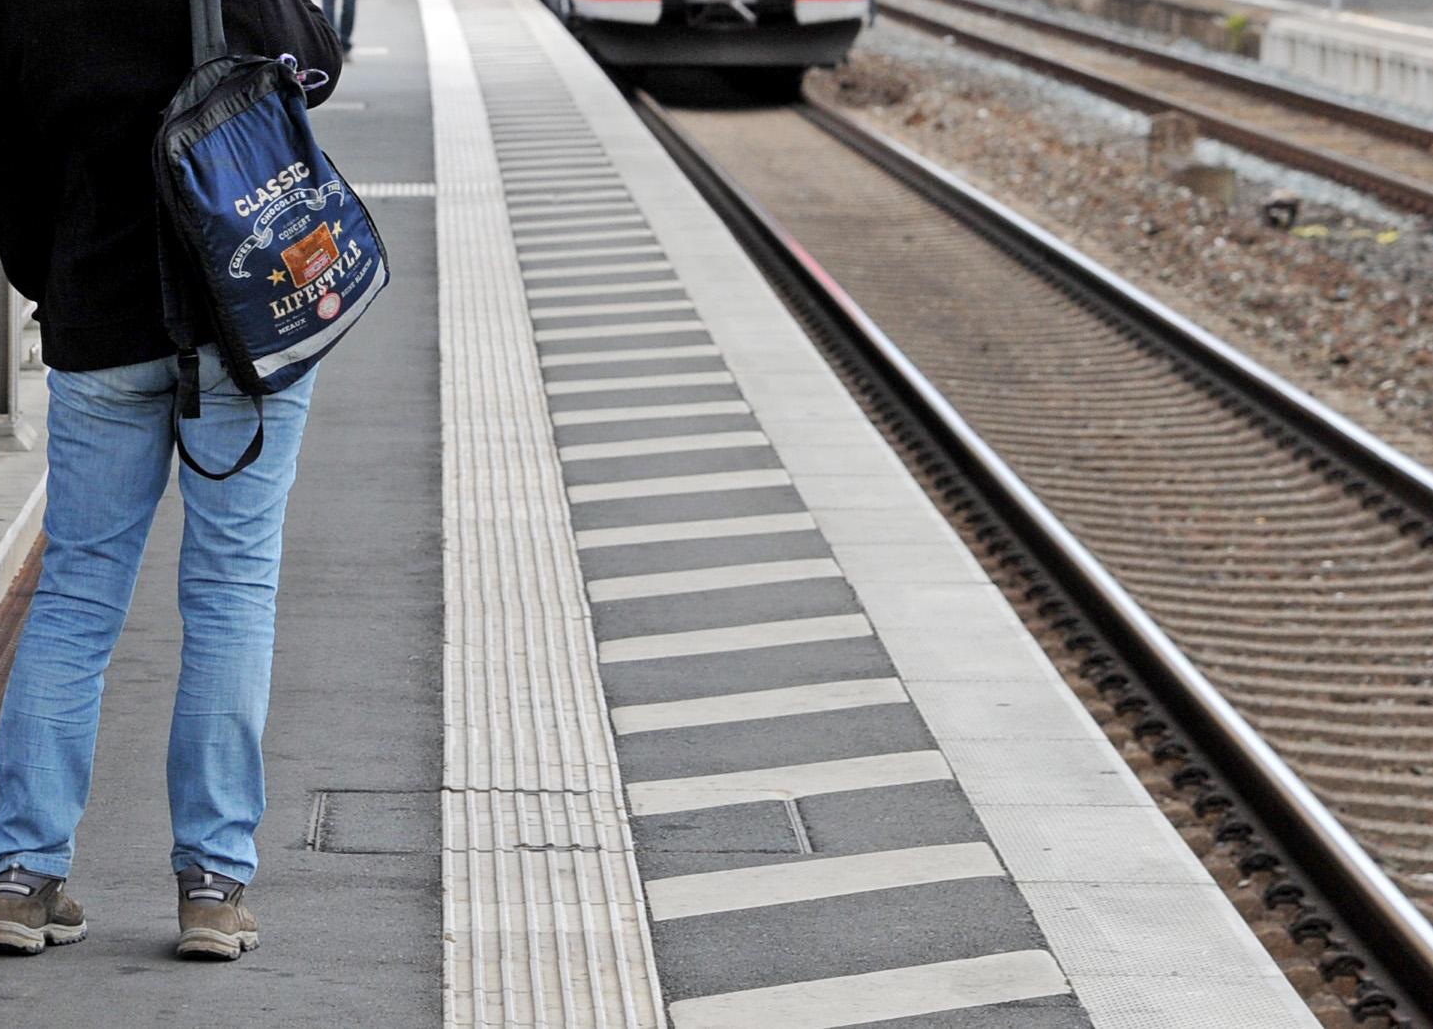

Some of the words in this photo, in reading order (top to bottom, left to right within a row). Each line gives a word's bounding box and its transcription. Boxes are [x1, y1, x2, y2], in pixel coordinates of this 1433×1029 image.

[234, 161, 310, 217] CLASSIC
[260, 190, 306, 225] CHOCOLATS
[278, 214, 311, 241] CONCERT
[269, 239, 362, 319] LIFESTYLE
